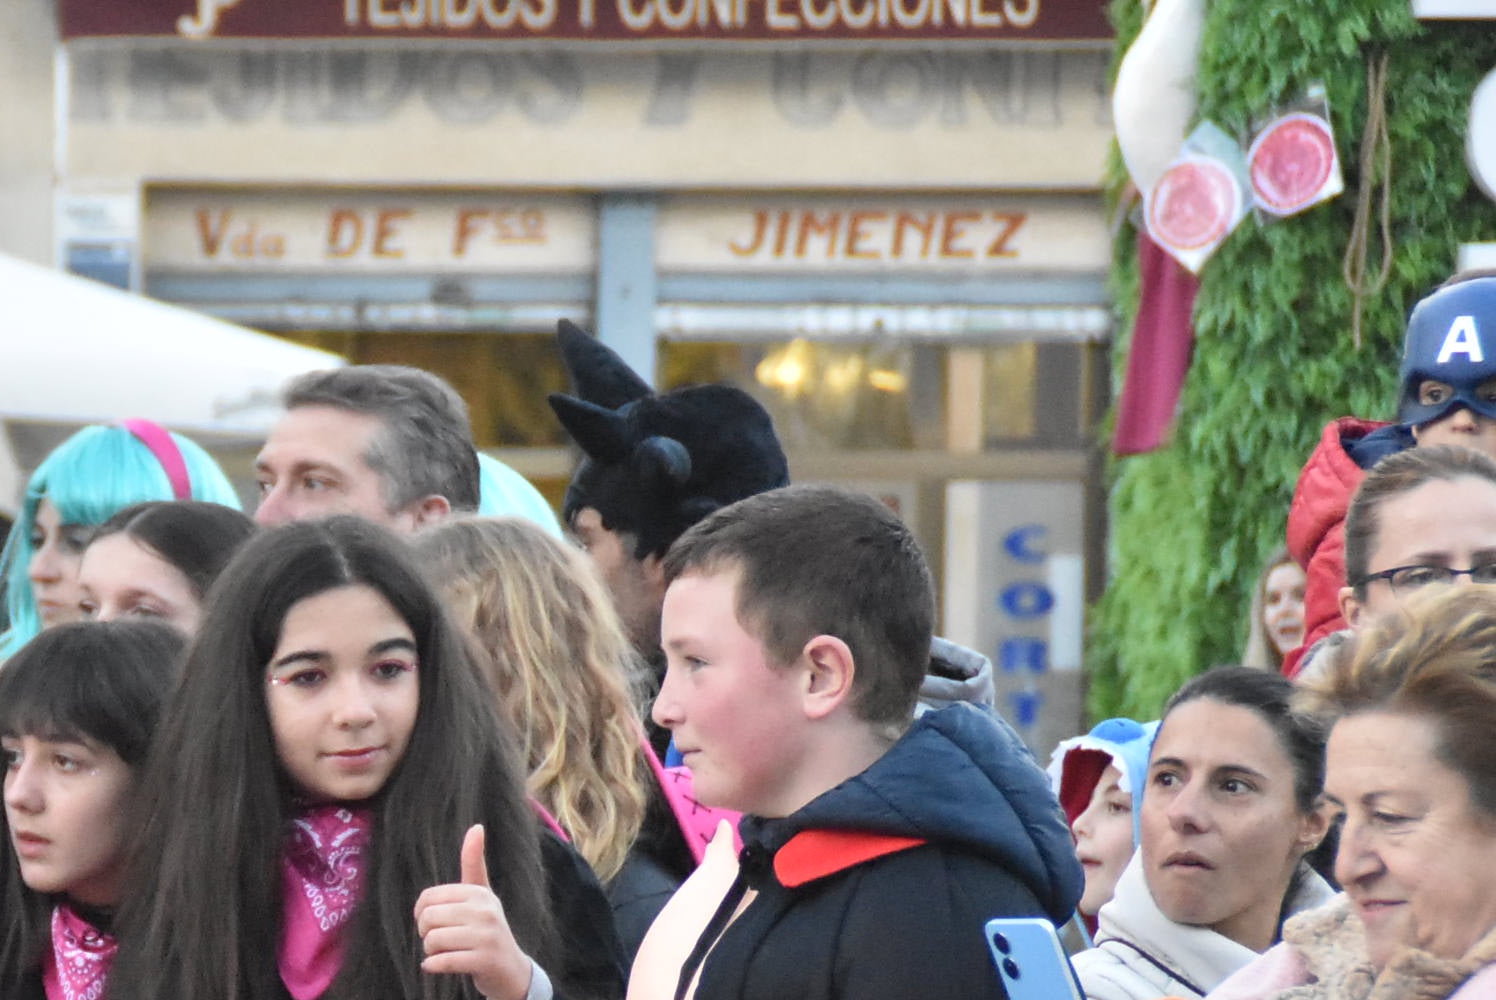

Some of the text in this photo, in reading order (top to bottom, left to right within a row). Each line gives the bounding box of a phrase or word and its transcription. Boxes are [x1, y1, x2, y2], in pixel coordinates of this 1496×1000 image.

[324, 207, 414, 259] DE
[728, 210, 1029, 259] JIMENEZ
[1437, 315, 1485, 364] A
